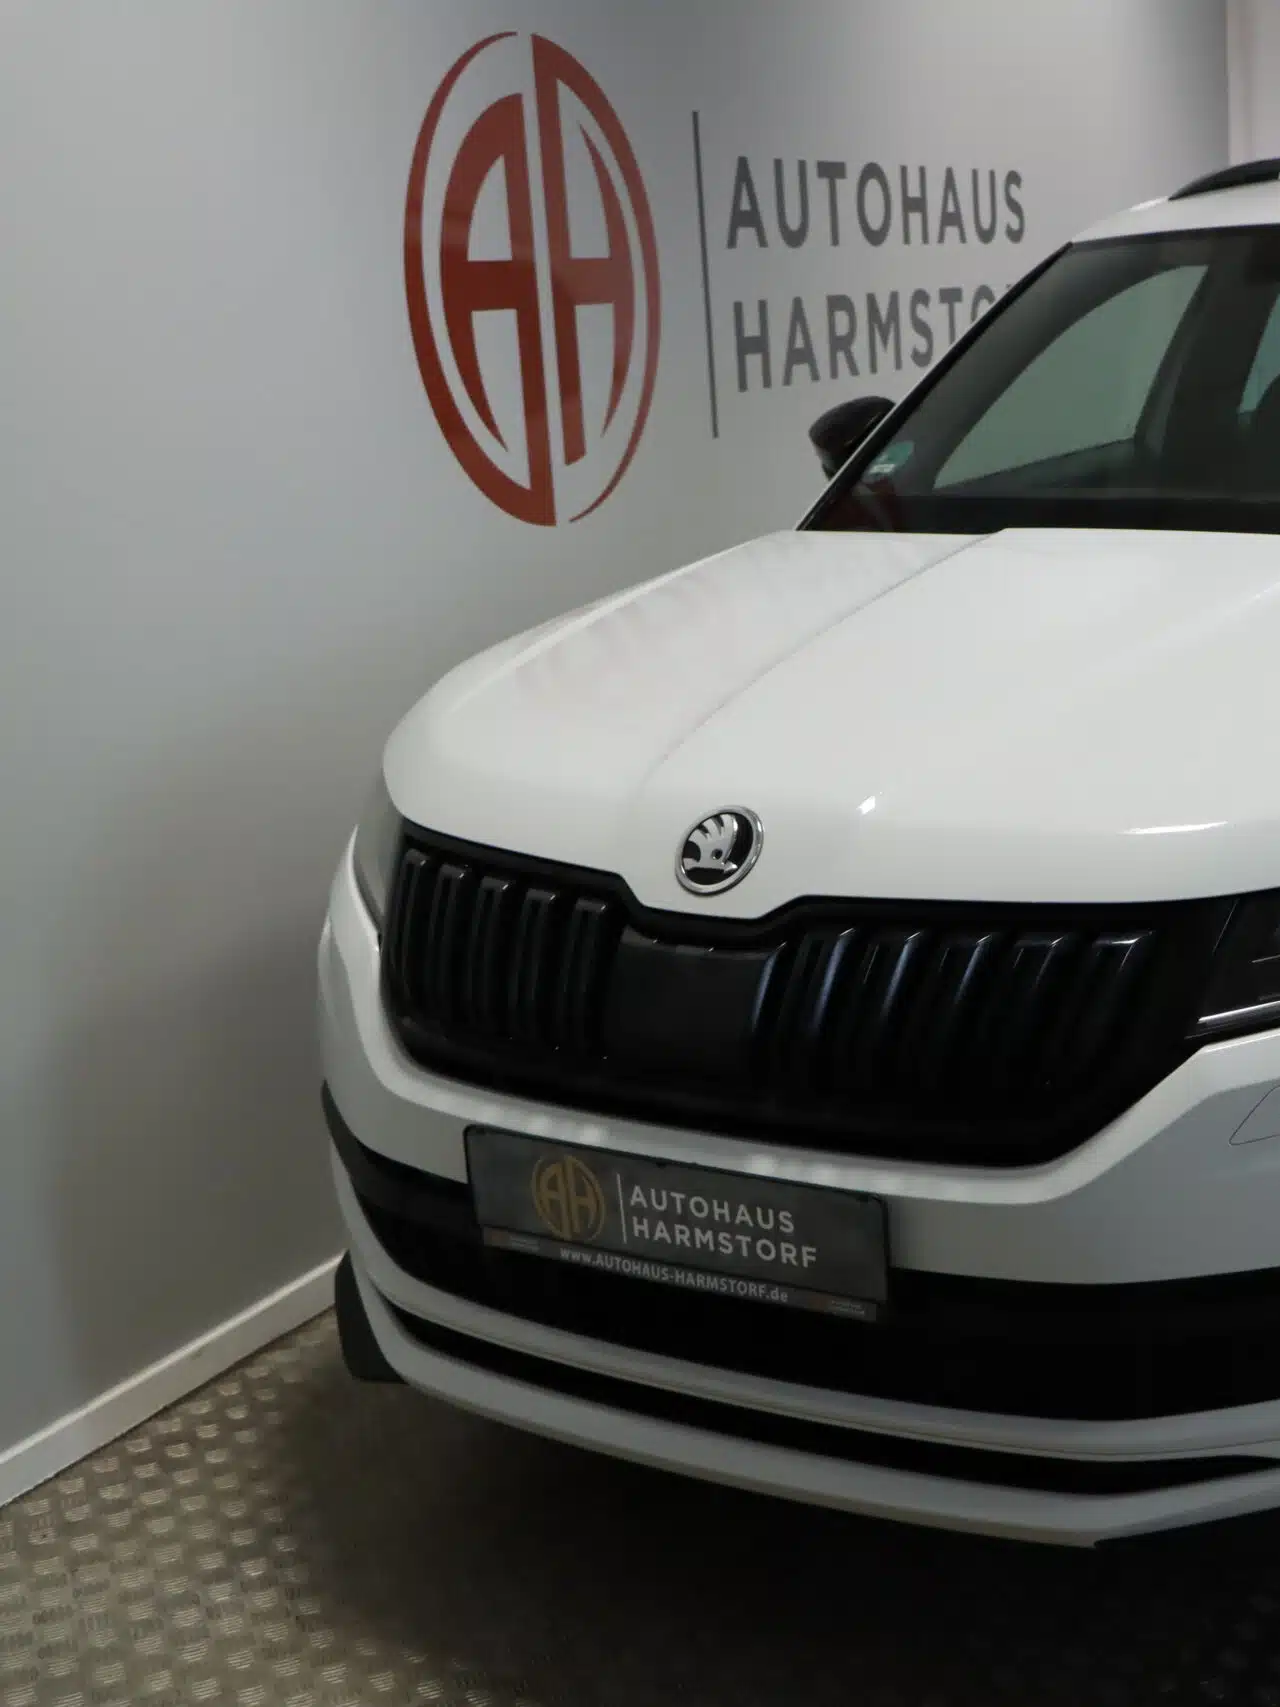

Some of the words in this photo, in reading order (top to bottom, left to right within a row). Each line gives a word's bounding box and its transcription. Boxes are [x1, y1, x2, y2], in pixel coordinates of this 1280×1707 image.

[726, 156, 1025, 249] AUTOHAUS
[732, 285, 1009, 393] HARMST
[630, 1185, 794, 1234] AUTOHAUS
[632, 1216, 817, 1268] HARMSTORF
[560, 1246, 789, 1302] www.AUTOHAUS-HARMSTORF.de
